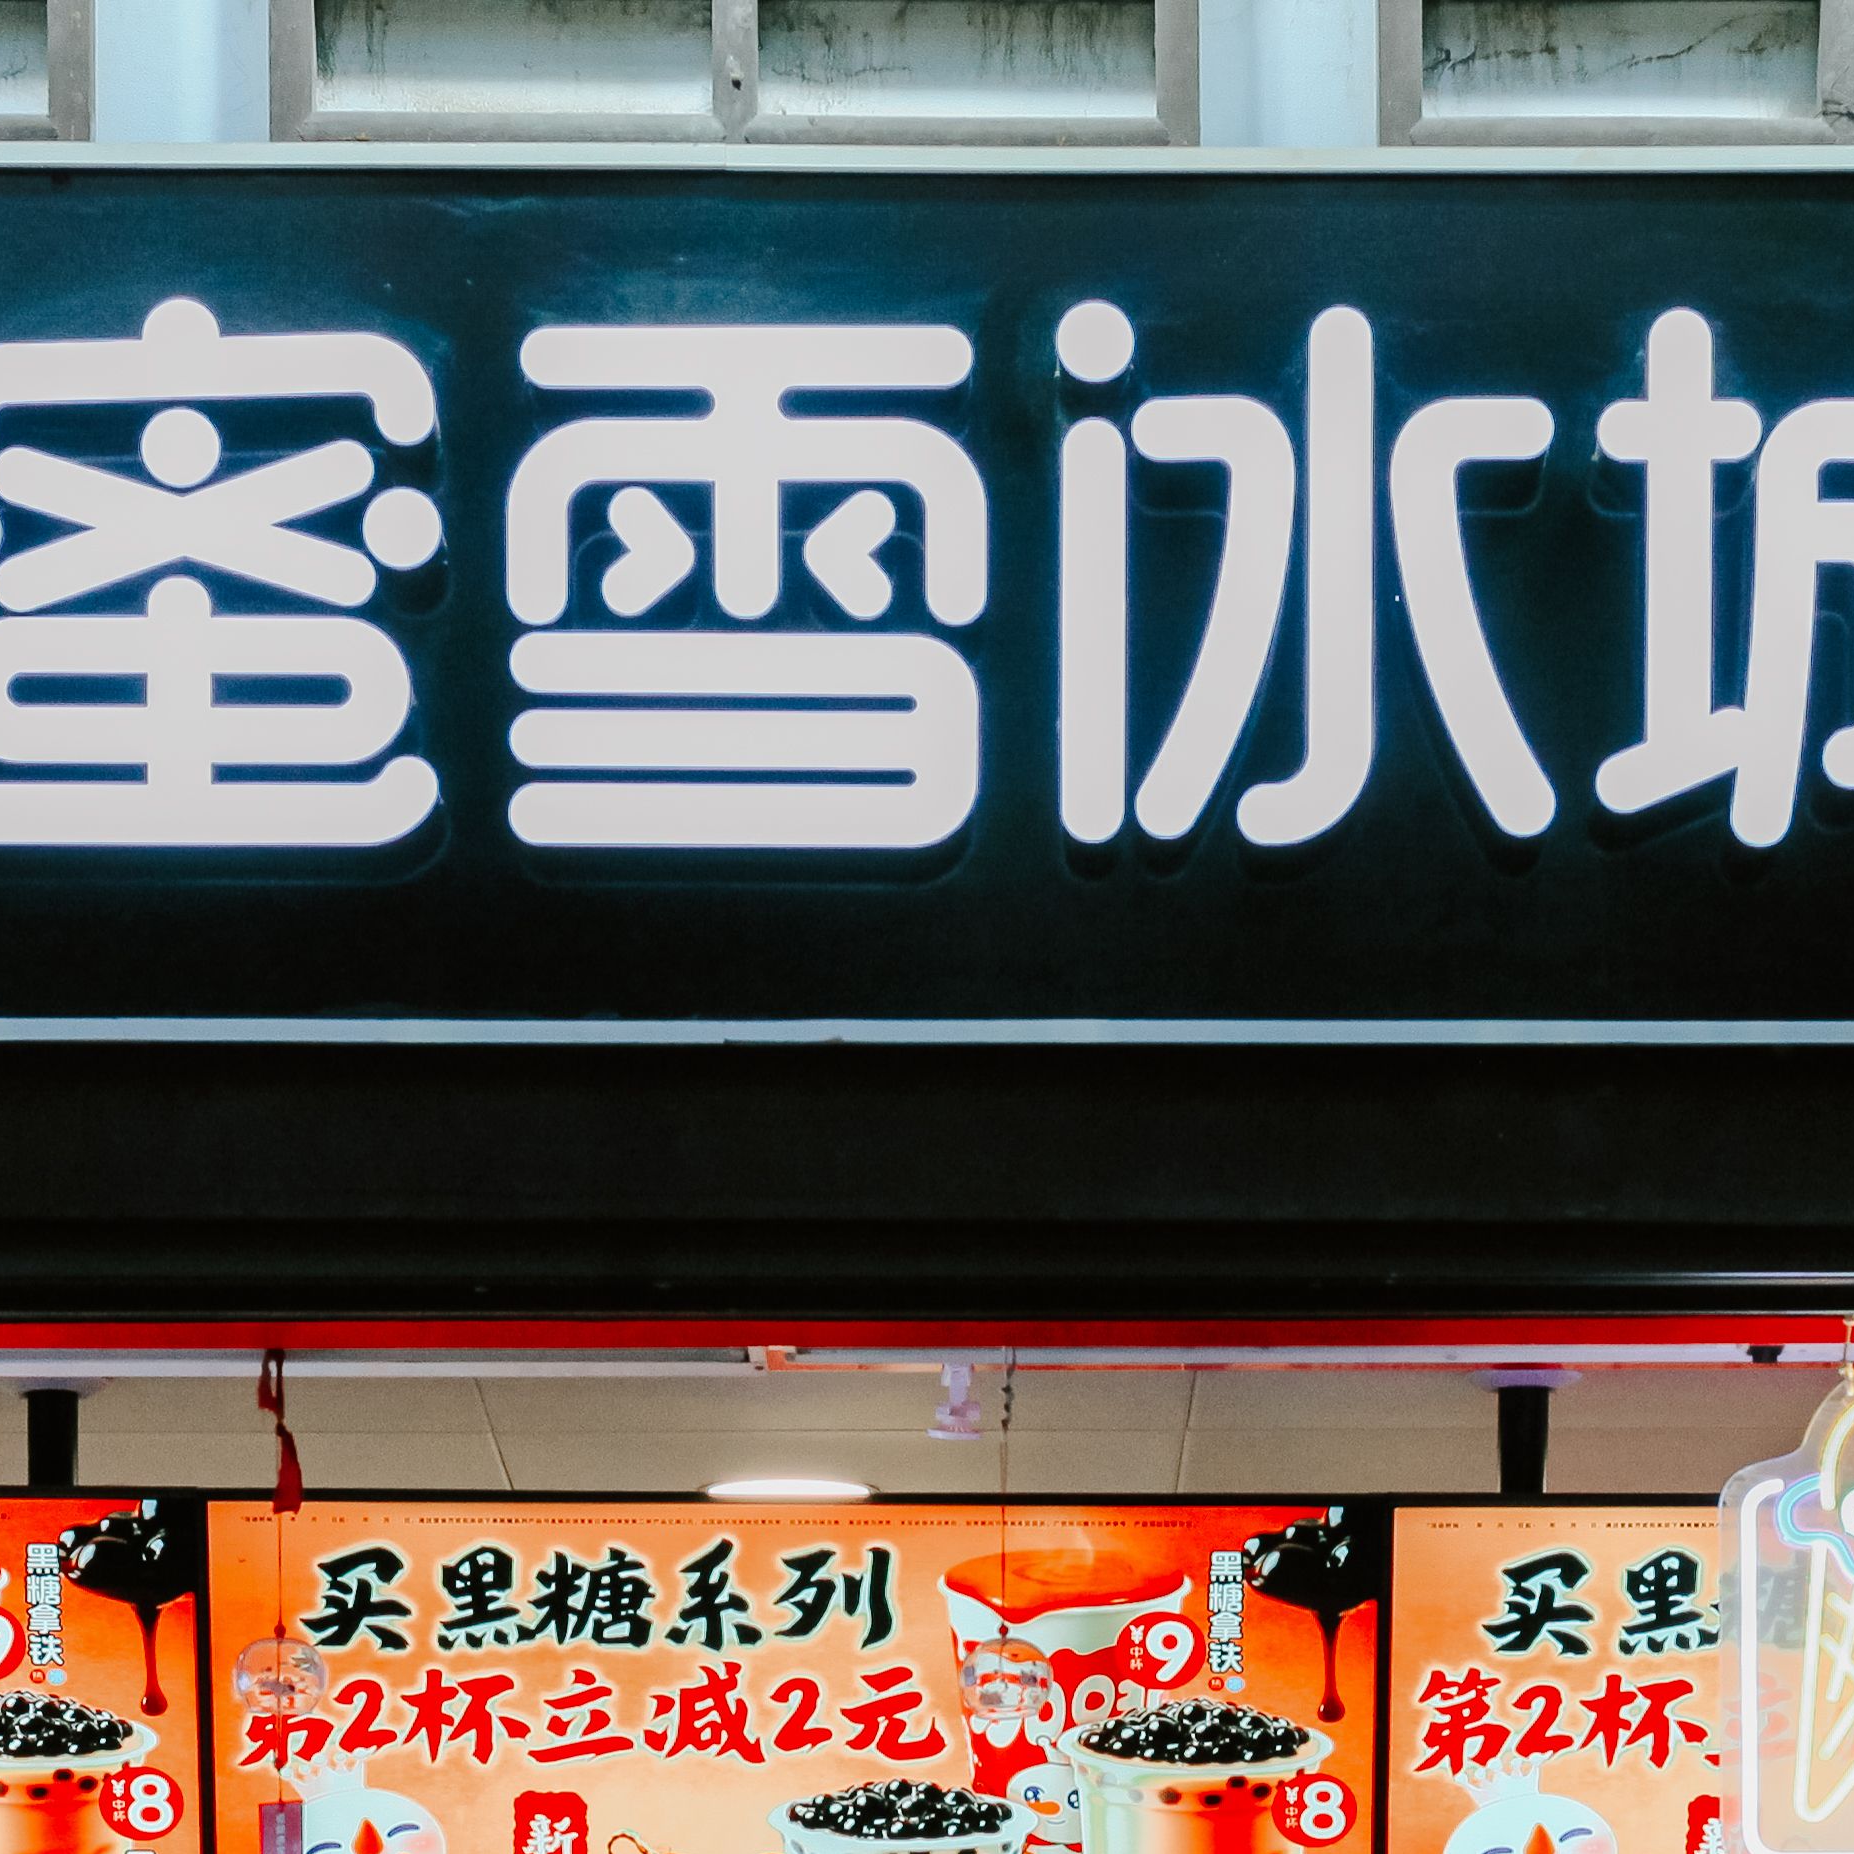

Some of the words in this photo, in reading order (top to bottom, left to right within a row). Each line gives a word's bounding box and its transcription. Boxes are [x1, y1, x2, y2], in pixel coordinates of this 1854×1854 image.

[26, 1543, 64, 1667] 黑糖拿铁
[301, 1544, 899, 1650] 买黑糖系列
[1208, 1550, 1244, 1675] 黑糖拿铁
[239, 1664, 944, 1769] 第2杯立减2元
